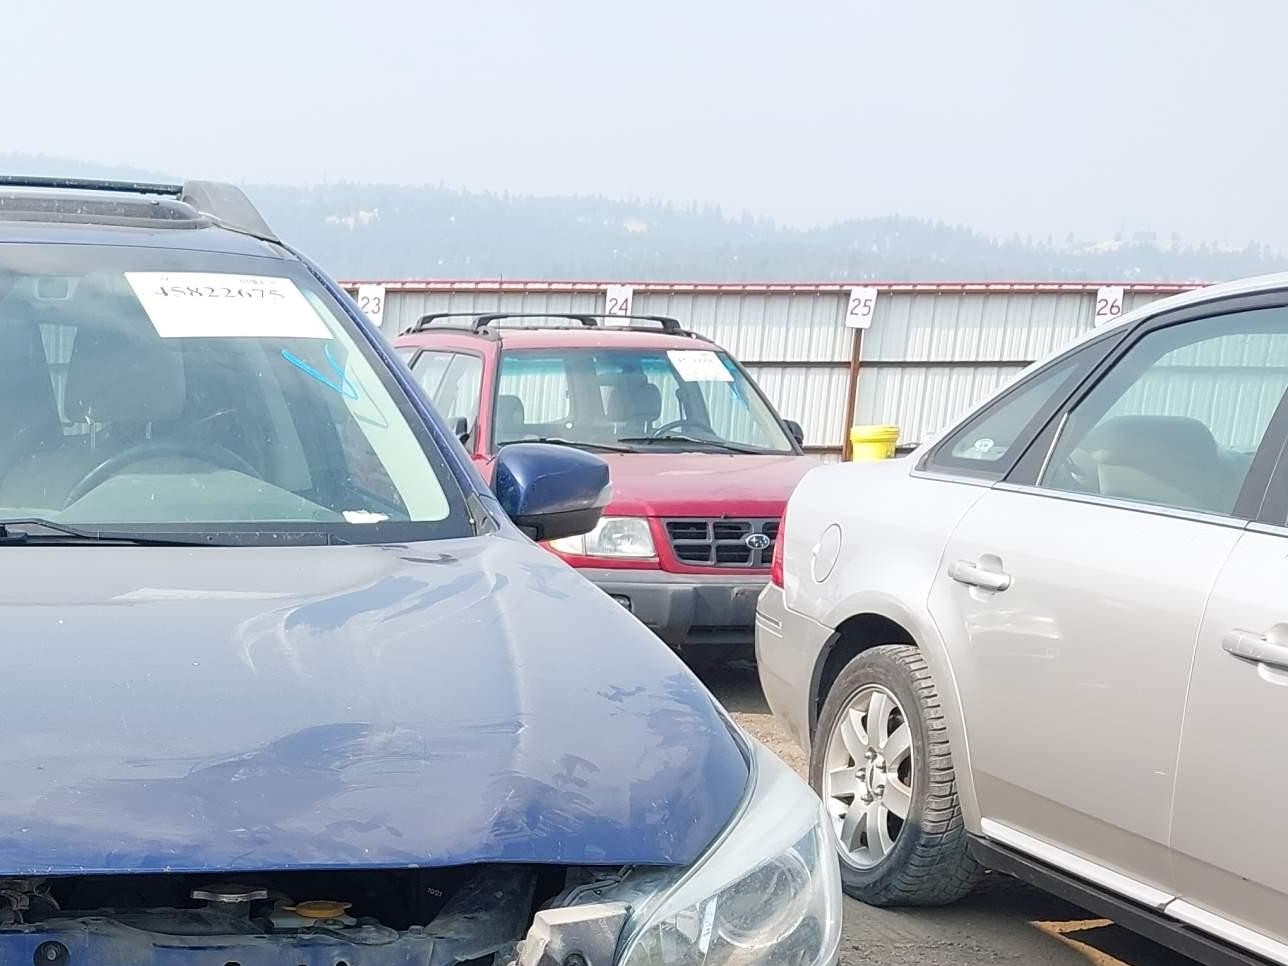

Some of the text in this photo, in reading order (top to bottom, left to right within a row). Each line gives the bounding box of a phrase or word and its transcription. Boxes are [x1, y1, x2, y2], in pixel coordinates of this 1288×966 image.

[361, 296, 381, 314] 23
[608, 297, 629, 316] 24
[850, 298, 872, 316] 25
[1096, 298, 1121, 316] 26
